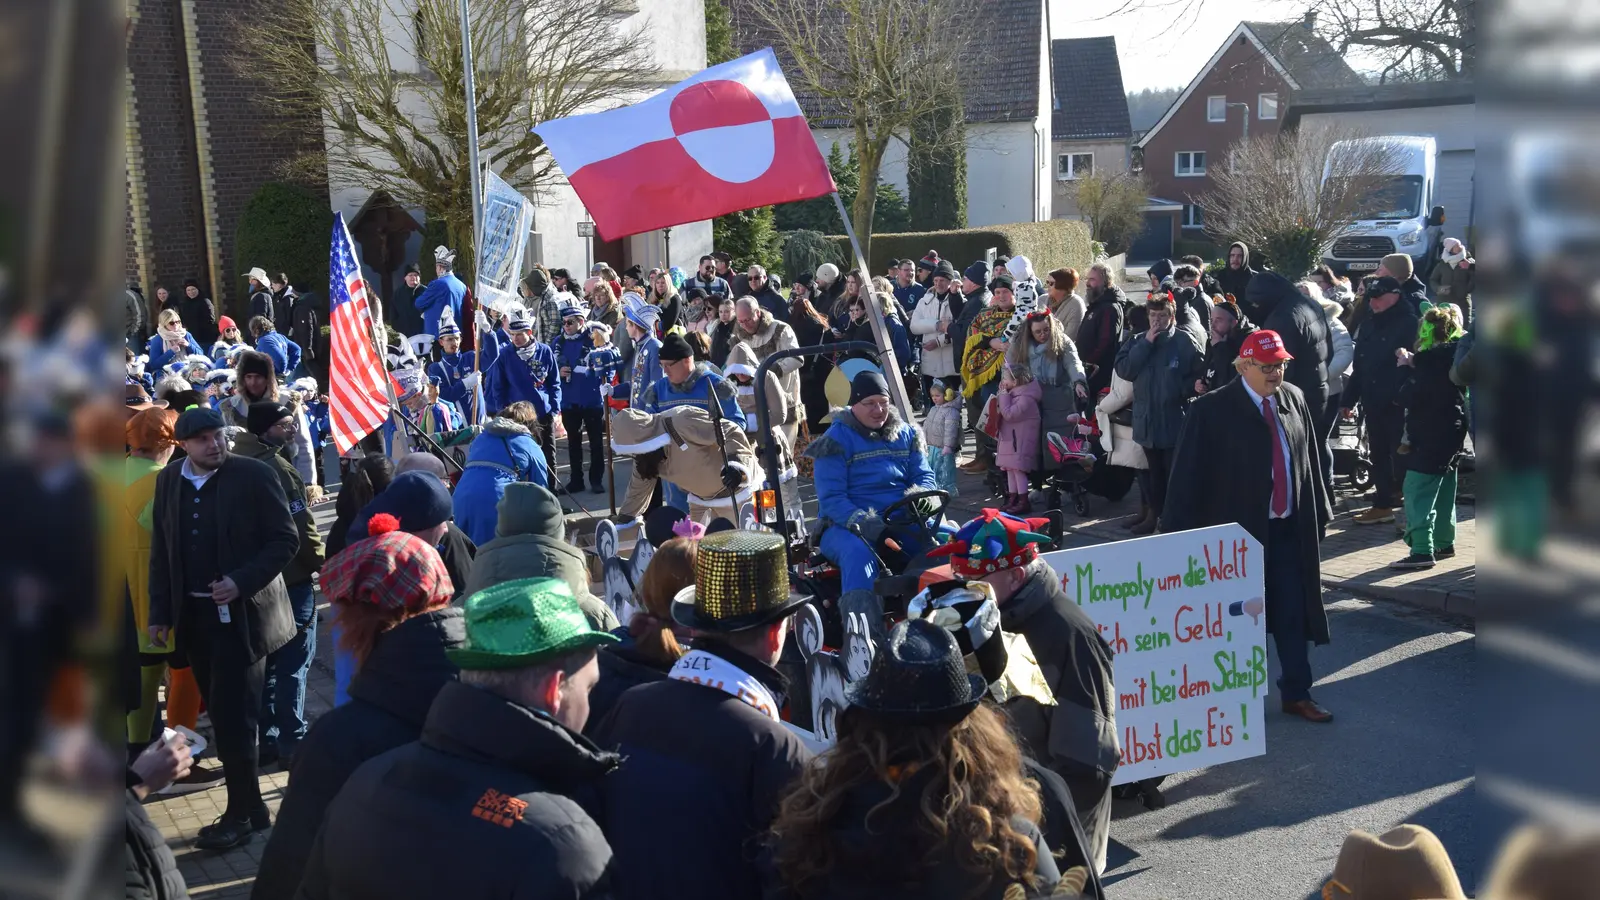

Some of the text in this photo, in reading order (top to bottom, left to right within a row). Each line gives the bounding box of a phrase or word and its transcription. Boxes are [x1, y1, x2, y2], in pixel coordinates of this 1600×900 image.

[1075, 562, 1155, 612] Monopoly
[1157, 573, 1182, 592] um
[1183, 554, 1207, 589] die
[1203, 538, 1249, 583] Welt
[1134, 616, 1172, 652] sein
[1120, 645, 1267, 710] mit bei dem Scheiß
[1165, 718, 1204, 758] das
